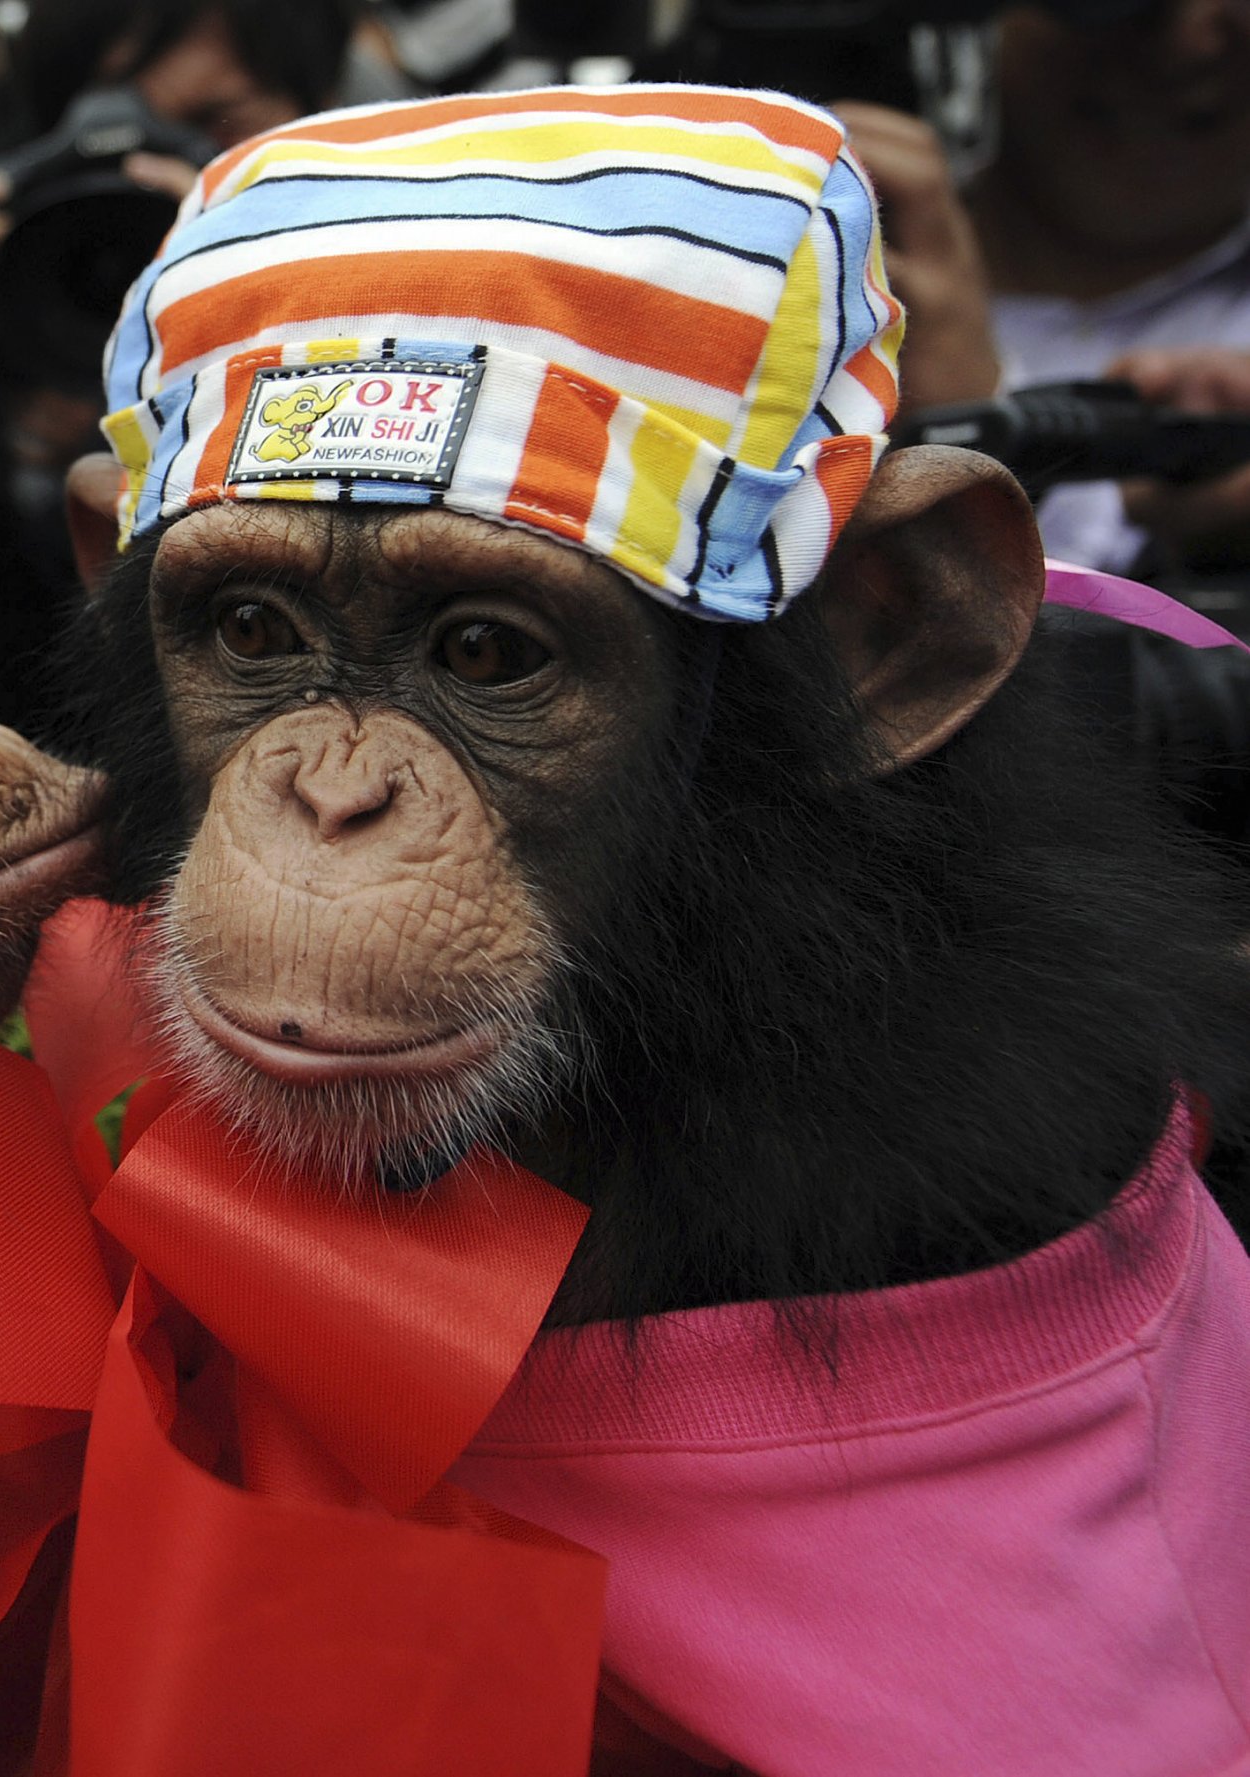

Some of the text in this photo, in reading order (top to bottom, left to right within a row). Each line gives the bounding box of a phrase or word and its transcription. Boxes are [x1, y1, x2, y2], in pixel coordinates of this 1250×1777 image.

[321, 417, 439, 443] XIN SHI JI
